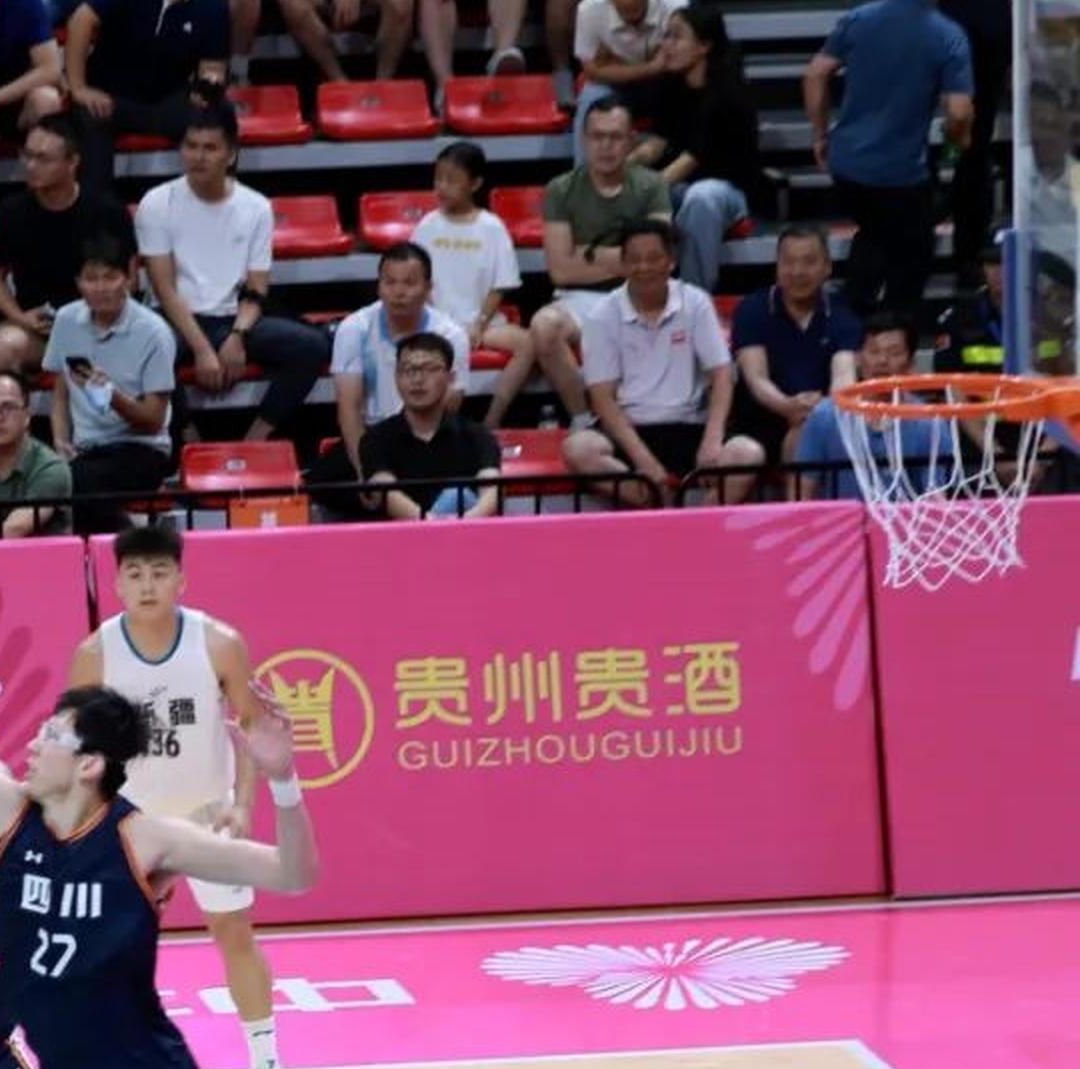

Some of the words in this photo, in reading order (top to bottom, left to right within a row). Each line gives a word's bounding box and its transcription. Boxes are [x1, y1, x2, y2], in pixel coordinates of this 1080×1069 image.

[394, 642, 741, 729] 贵州贵酒
[397, 725, 743, 770] GUIZHOUGUIJIU
[20, 873, 103, 919] 四川
[29, 926, 78, 979] 27
